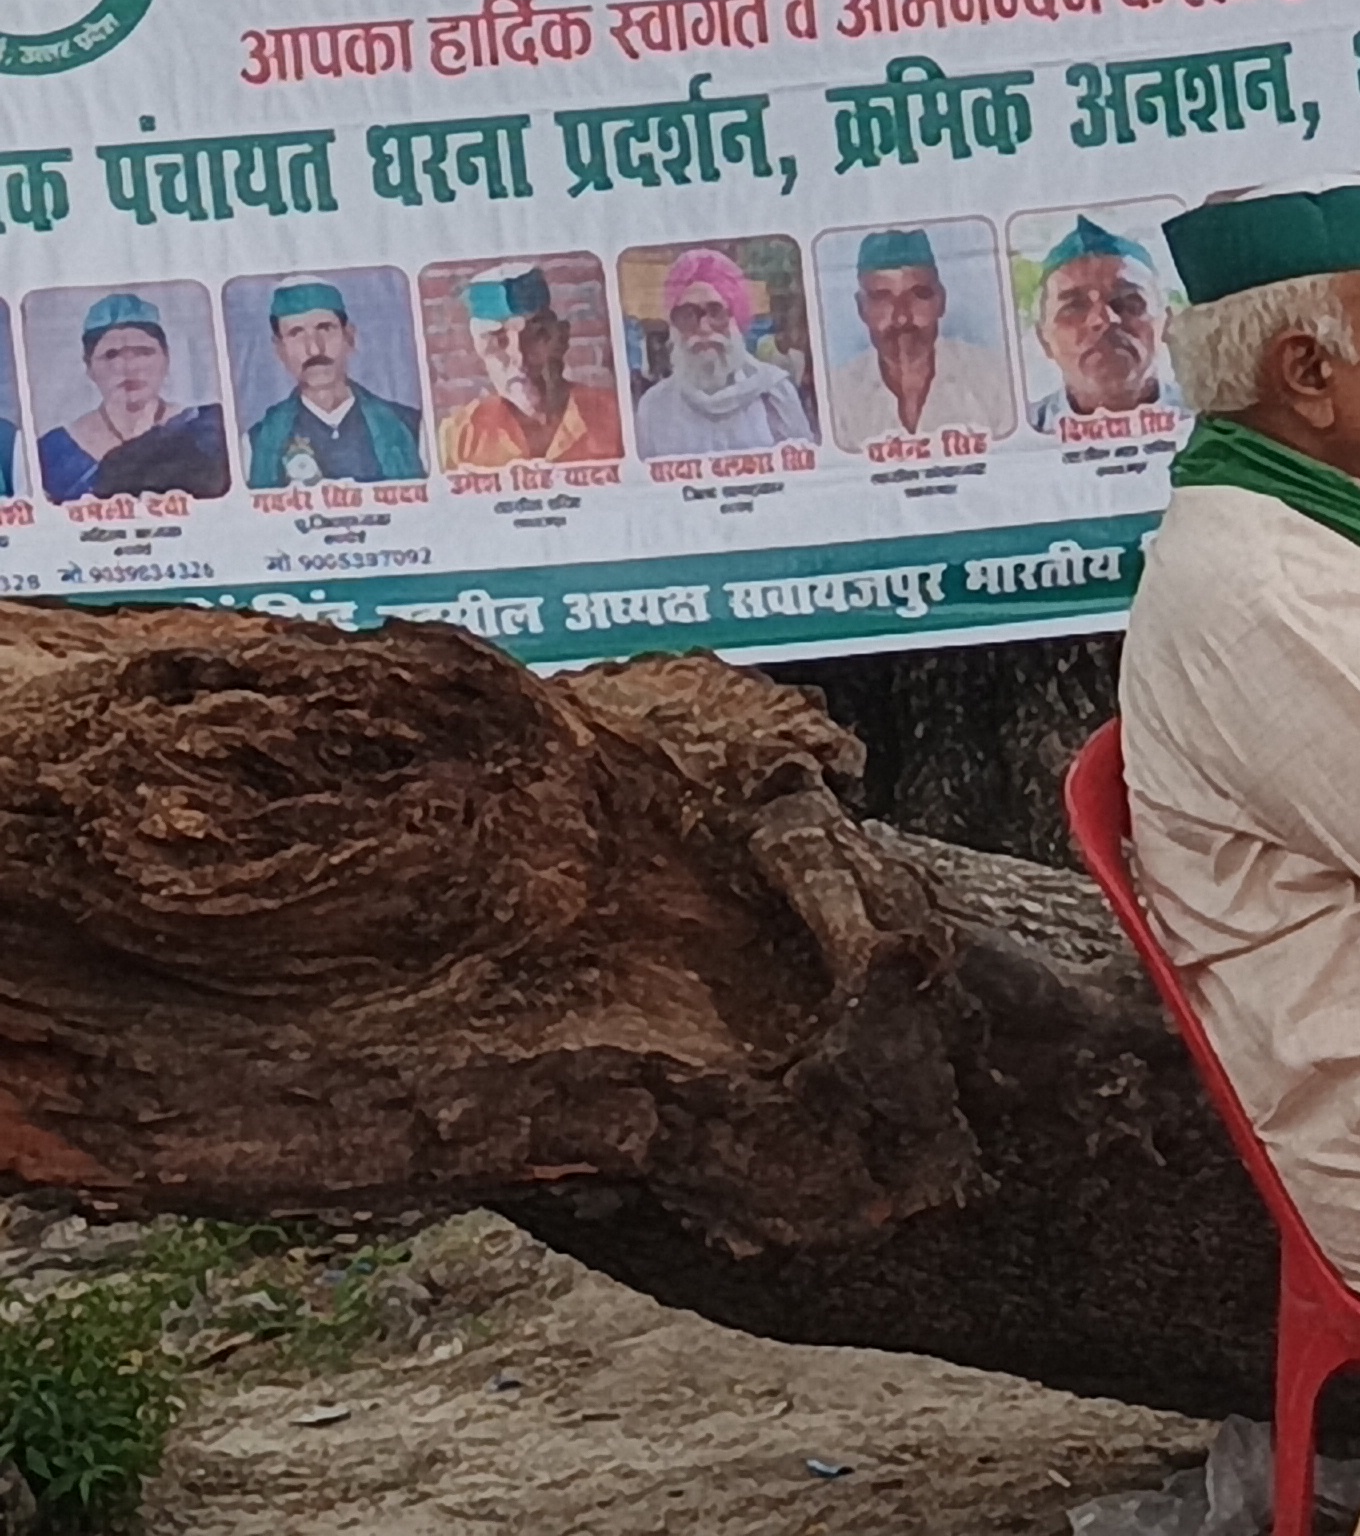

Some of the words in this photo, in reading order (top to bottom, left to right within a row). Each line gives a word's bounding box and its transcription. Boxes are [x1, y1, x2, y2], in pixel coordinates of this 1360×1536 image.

[240, 18, 414, 85] आपका
[95, 113, 340, 226] पंचायत
[365, 113, 535, 207] धरना
[553, 72, 798, 199] प्रदर्शन,
[824, 54, 1036, 176] क्रमिक
[1066, 41, 1322, 148] अनशन,
[562, 584, 711, 632] अध्यक्ष
[722, 563, 948, 619] सवायजपुर
[964, 538, 1126, 596] भारतीय
